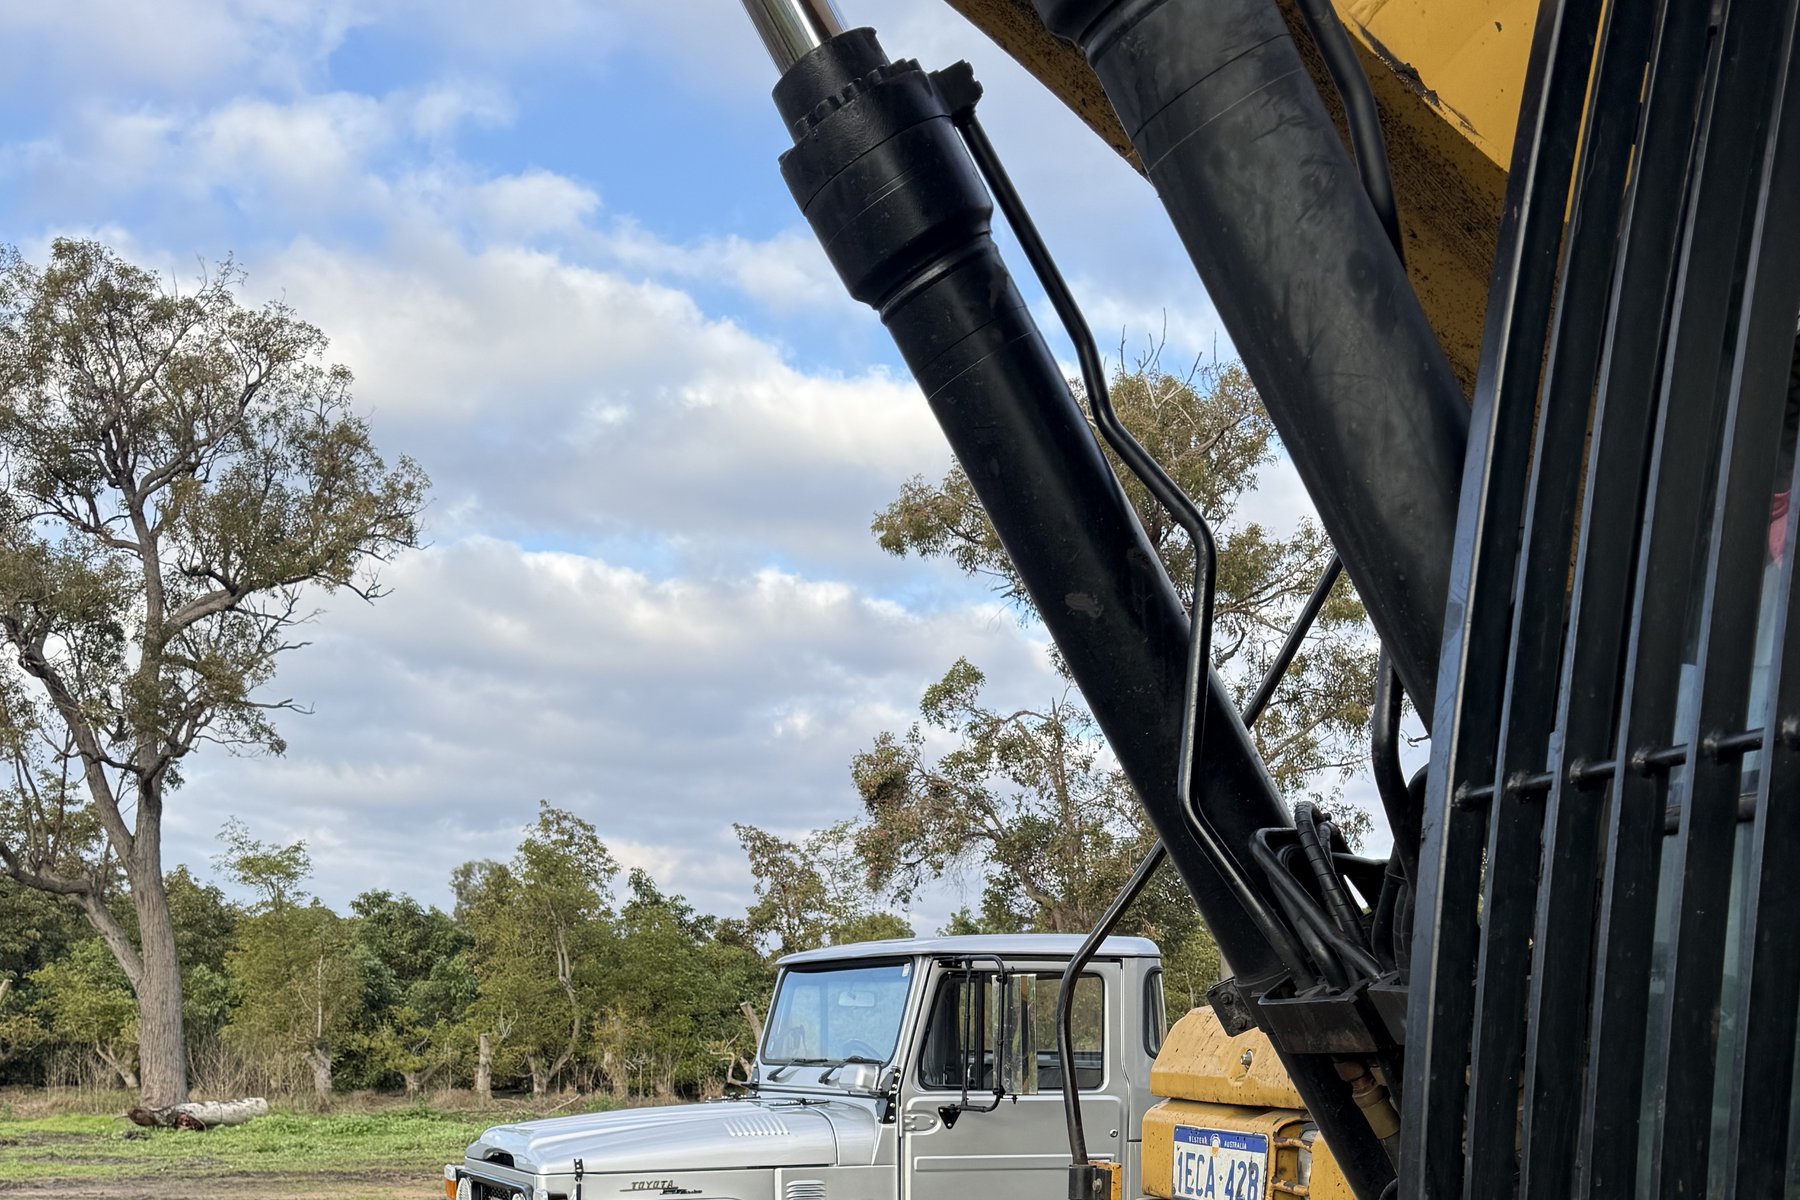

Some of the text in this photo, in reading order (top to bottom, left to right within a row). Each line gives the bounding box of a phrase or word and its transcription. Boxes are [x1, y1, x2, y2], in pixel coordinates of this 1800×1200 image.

[1188, 1135, 1247, 1150] WESTERN AUSTRALIA
[631, 1180, 675, 1191] TOYOTA
